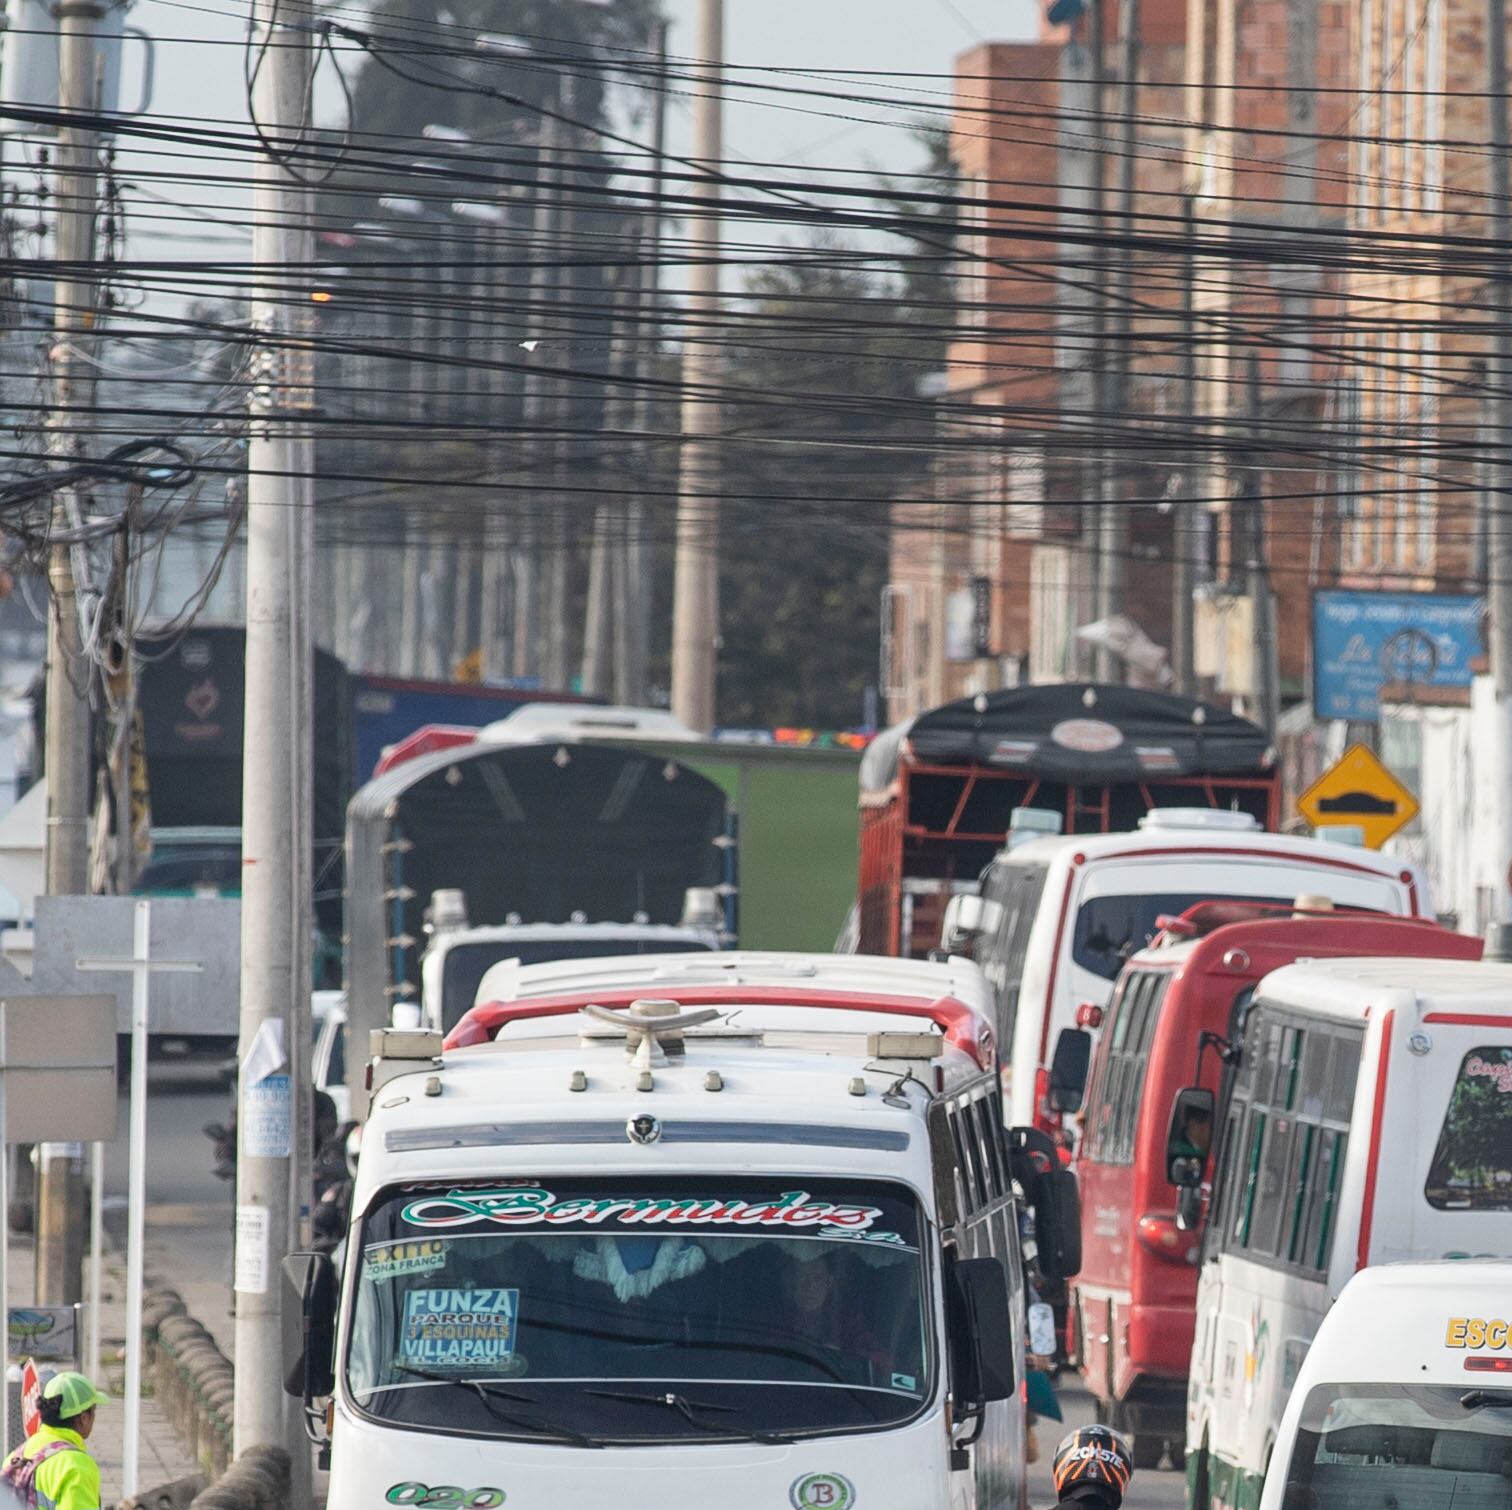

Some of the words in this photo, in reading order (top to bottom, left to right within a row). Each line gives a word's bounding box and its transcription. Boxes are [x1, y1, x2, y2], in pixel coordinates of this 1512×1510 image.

[401, 1187, 884, 1230] Bermudez
[363, 1240, 442, 1264] EXITO
[399, 1256, 444, 1270] FRANCA
[408, 1290, 513, 1318] FUNZA
[409, 1313, 507, 1325] PARQUE
[423, 1325, 510, 1340] ESQUINAS
[405, 1340, 511, 1357] VILLAPAUL
